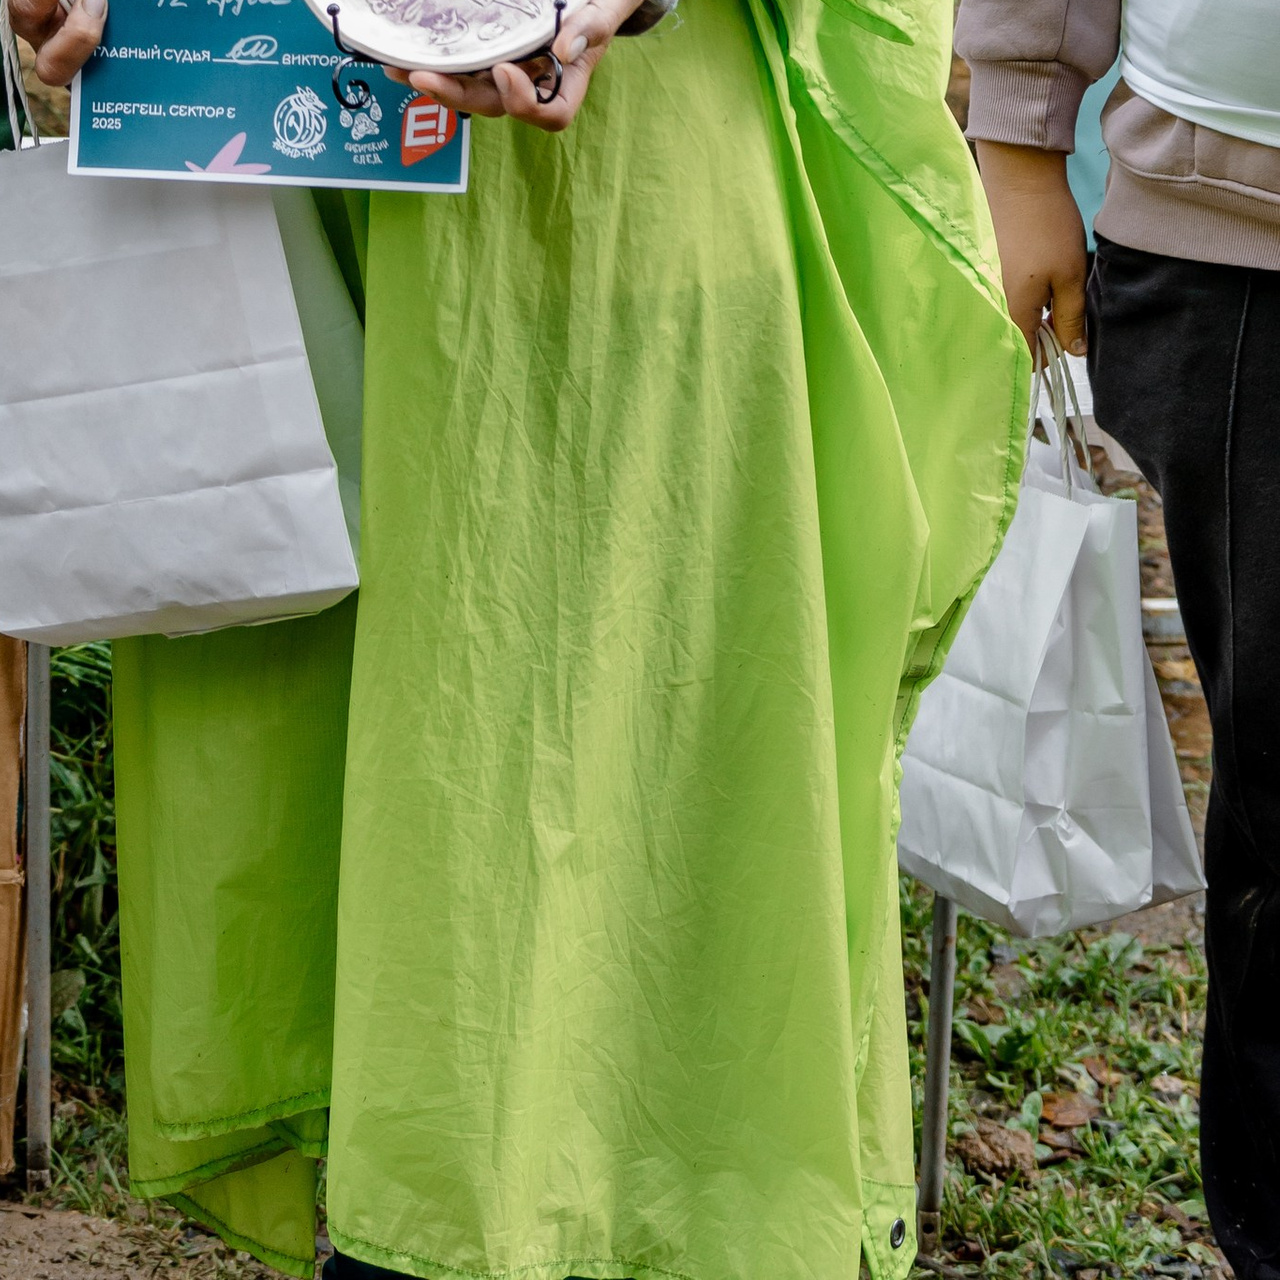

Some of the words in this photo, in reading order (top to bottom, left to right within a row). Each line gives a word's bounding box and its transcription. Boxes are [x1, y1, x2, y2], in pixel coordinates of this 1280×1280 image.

[94, 44, 161, 60] ГЛАВНЫЙ
[163, 49, 211, 64] СУДЬЯ
[92, 101, 167, 117] ШЕРЕГЕШ,
[169, 105, 225, 118] СЕКТОР
[92, 117, 122, 130] 2025
